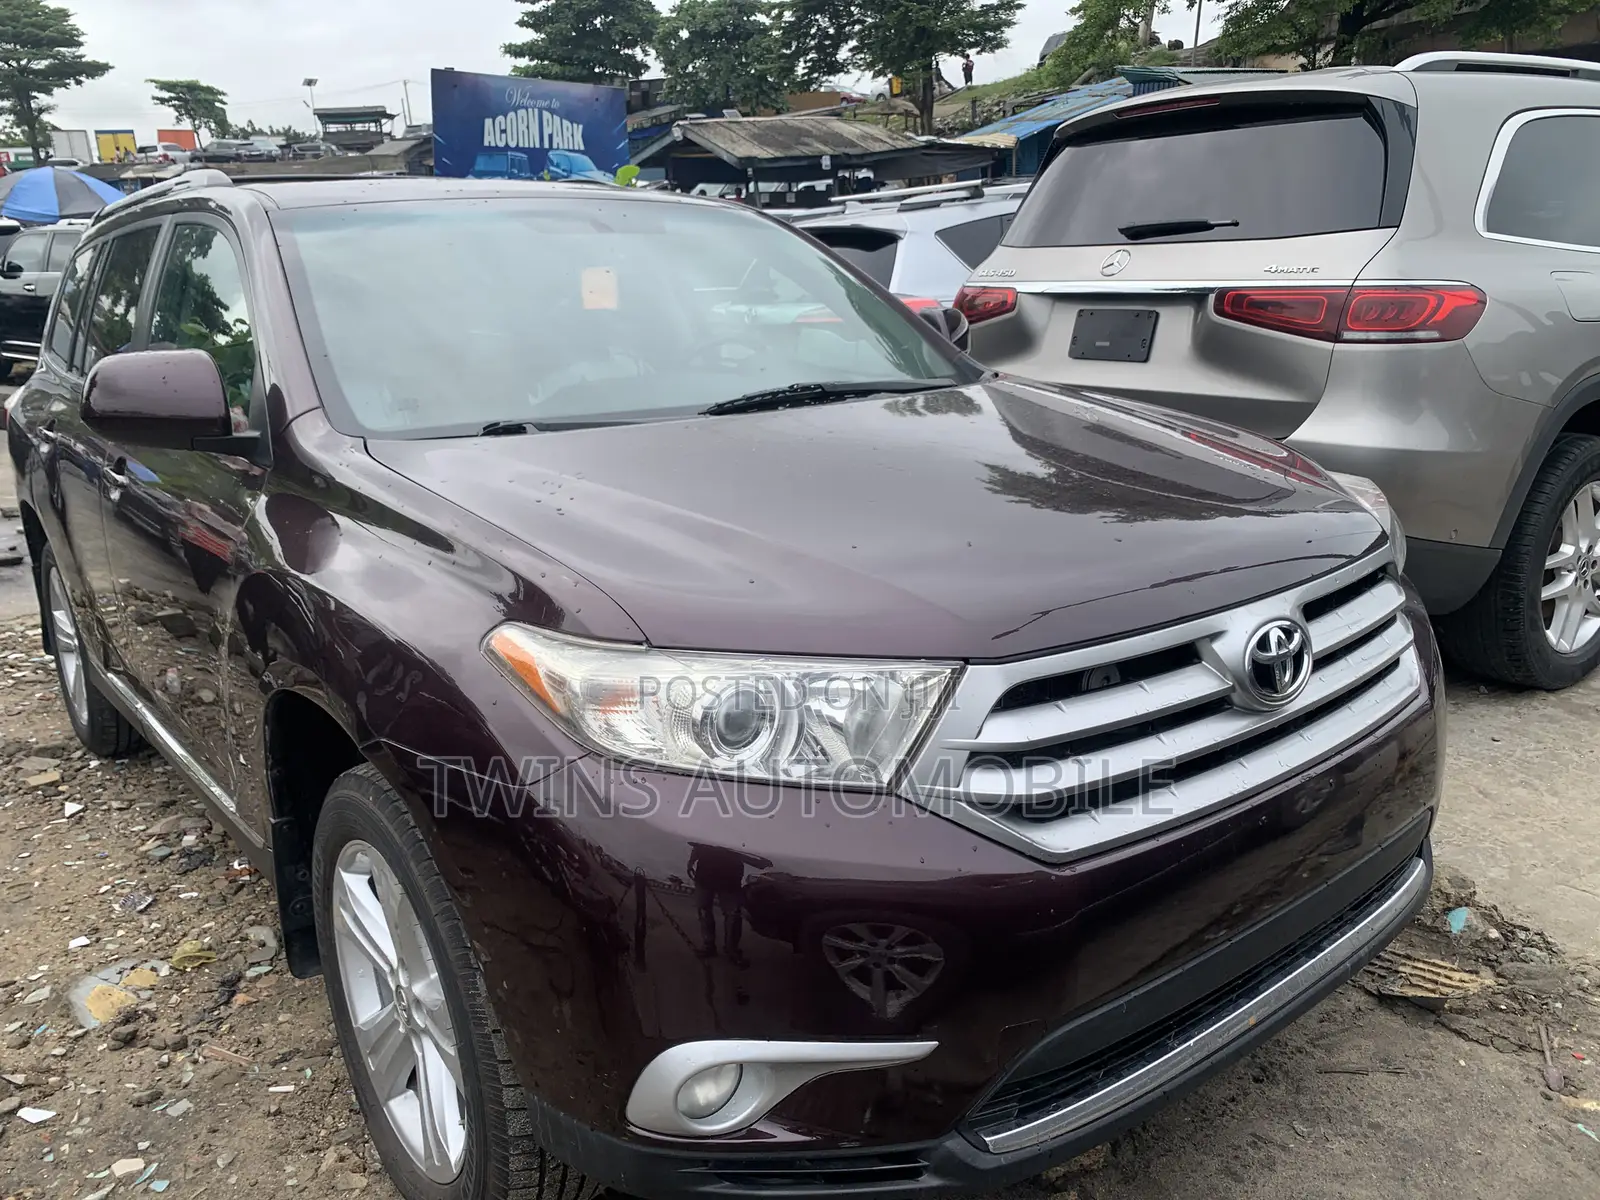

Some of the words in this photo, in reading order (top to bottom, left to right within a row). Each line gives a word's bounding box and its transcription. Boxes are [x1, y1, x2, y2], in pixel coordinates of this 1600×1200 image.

[505, 85, 548, 108] Welcome
[551, 98, 560, 109] to
[483, 108, 540, 148] ACORN
[542, 110, 585, 150] PARK
[1263, 264, 1319, 274] 4MATIC
